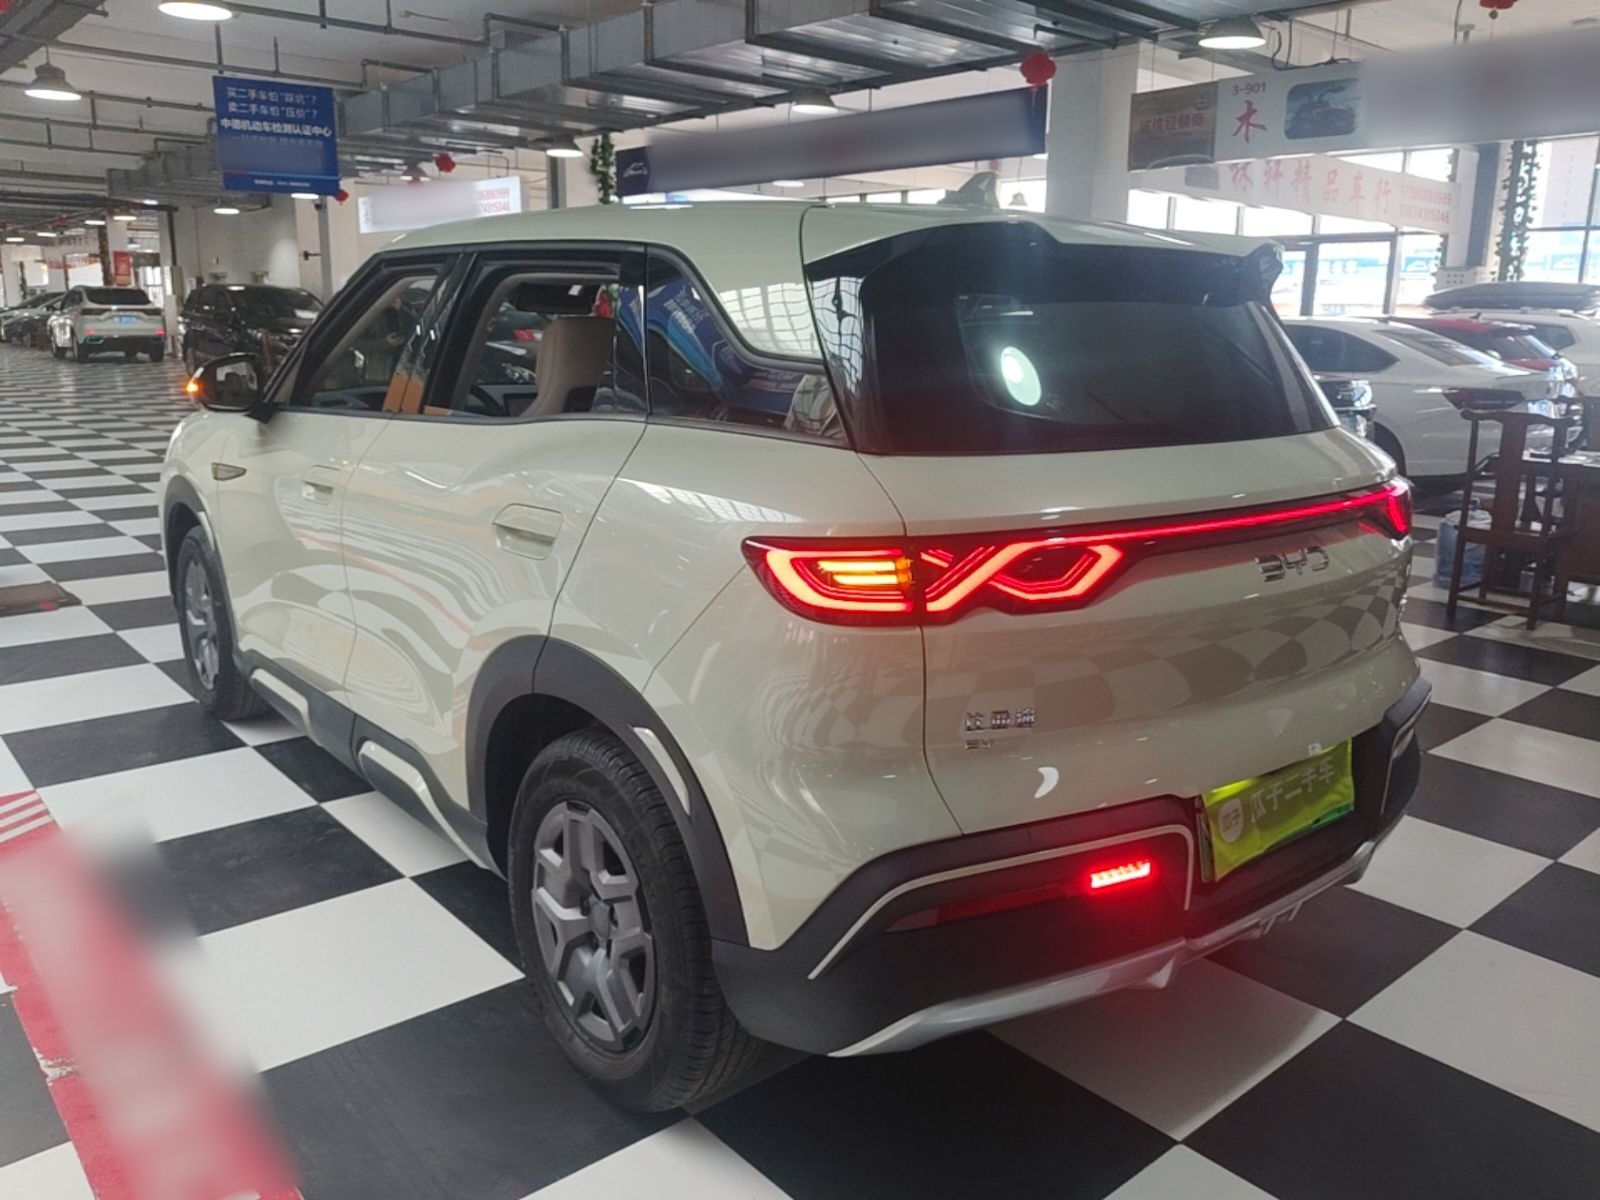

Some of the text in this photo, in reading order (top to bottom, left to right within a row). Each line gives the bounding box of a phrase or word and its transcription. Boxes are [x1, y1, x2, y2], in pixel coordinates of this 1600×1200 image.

[1231, 82, 1267, 96] 3-901
[1231, 100, 1268, 143] 木
[1255, 546, 1329, 583] BYD
[1251, 756, 1335, 824] 瓜子二手车
